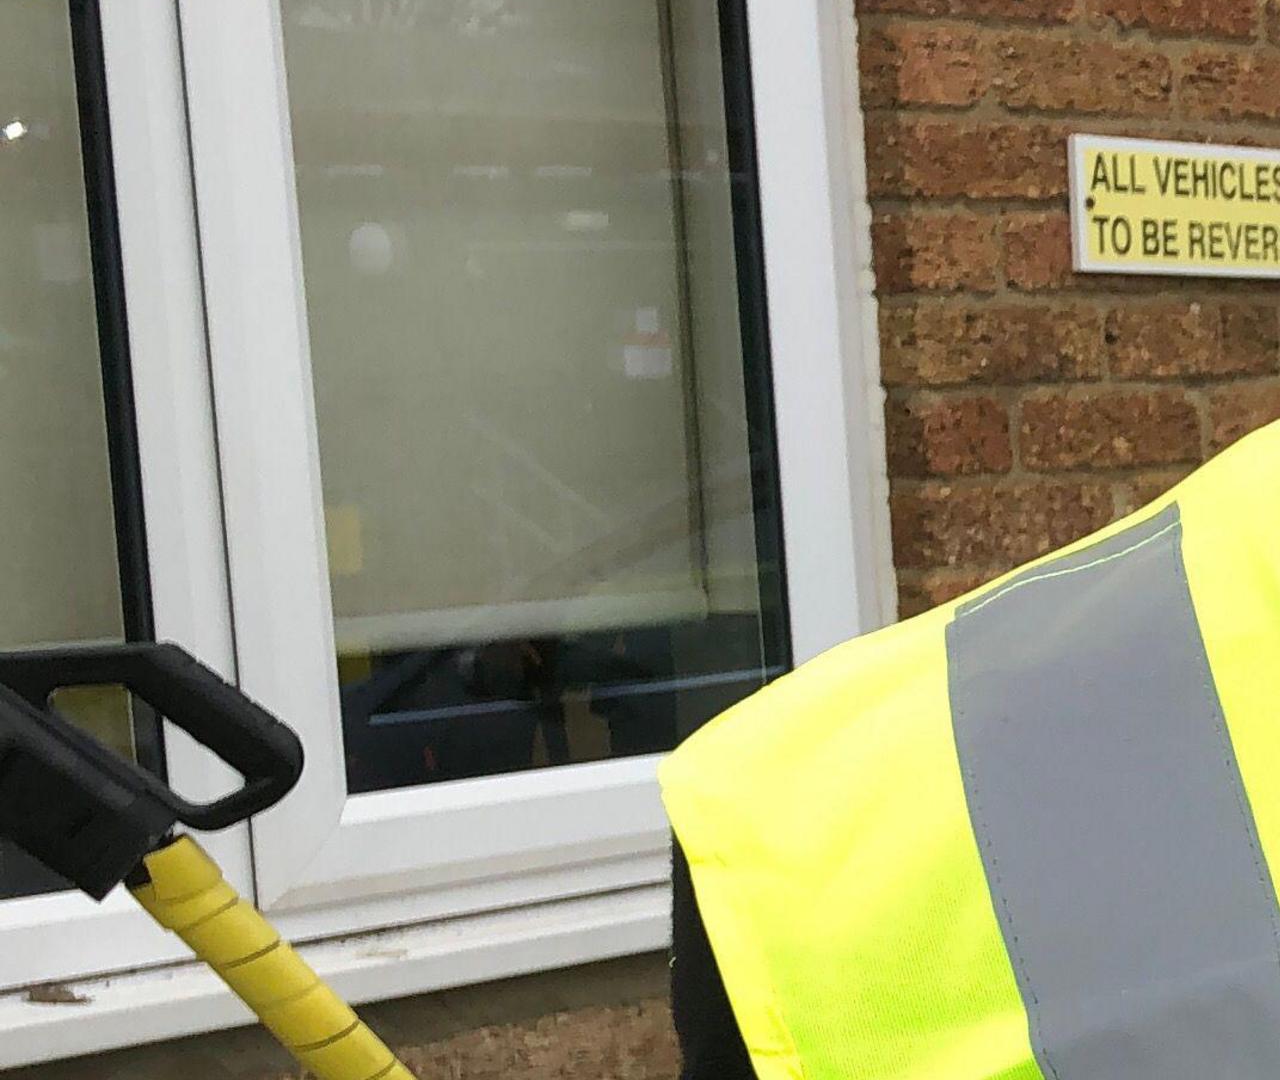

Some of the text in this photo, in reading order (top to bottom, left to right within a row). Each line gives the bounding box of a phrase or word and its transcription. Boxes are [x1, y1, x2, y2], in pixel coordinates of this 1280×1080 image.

[1090, 152, 1145, 193] ALL
[1092, 216, 1132, 255] TO
[1142, 218, 1178, 257] BE
